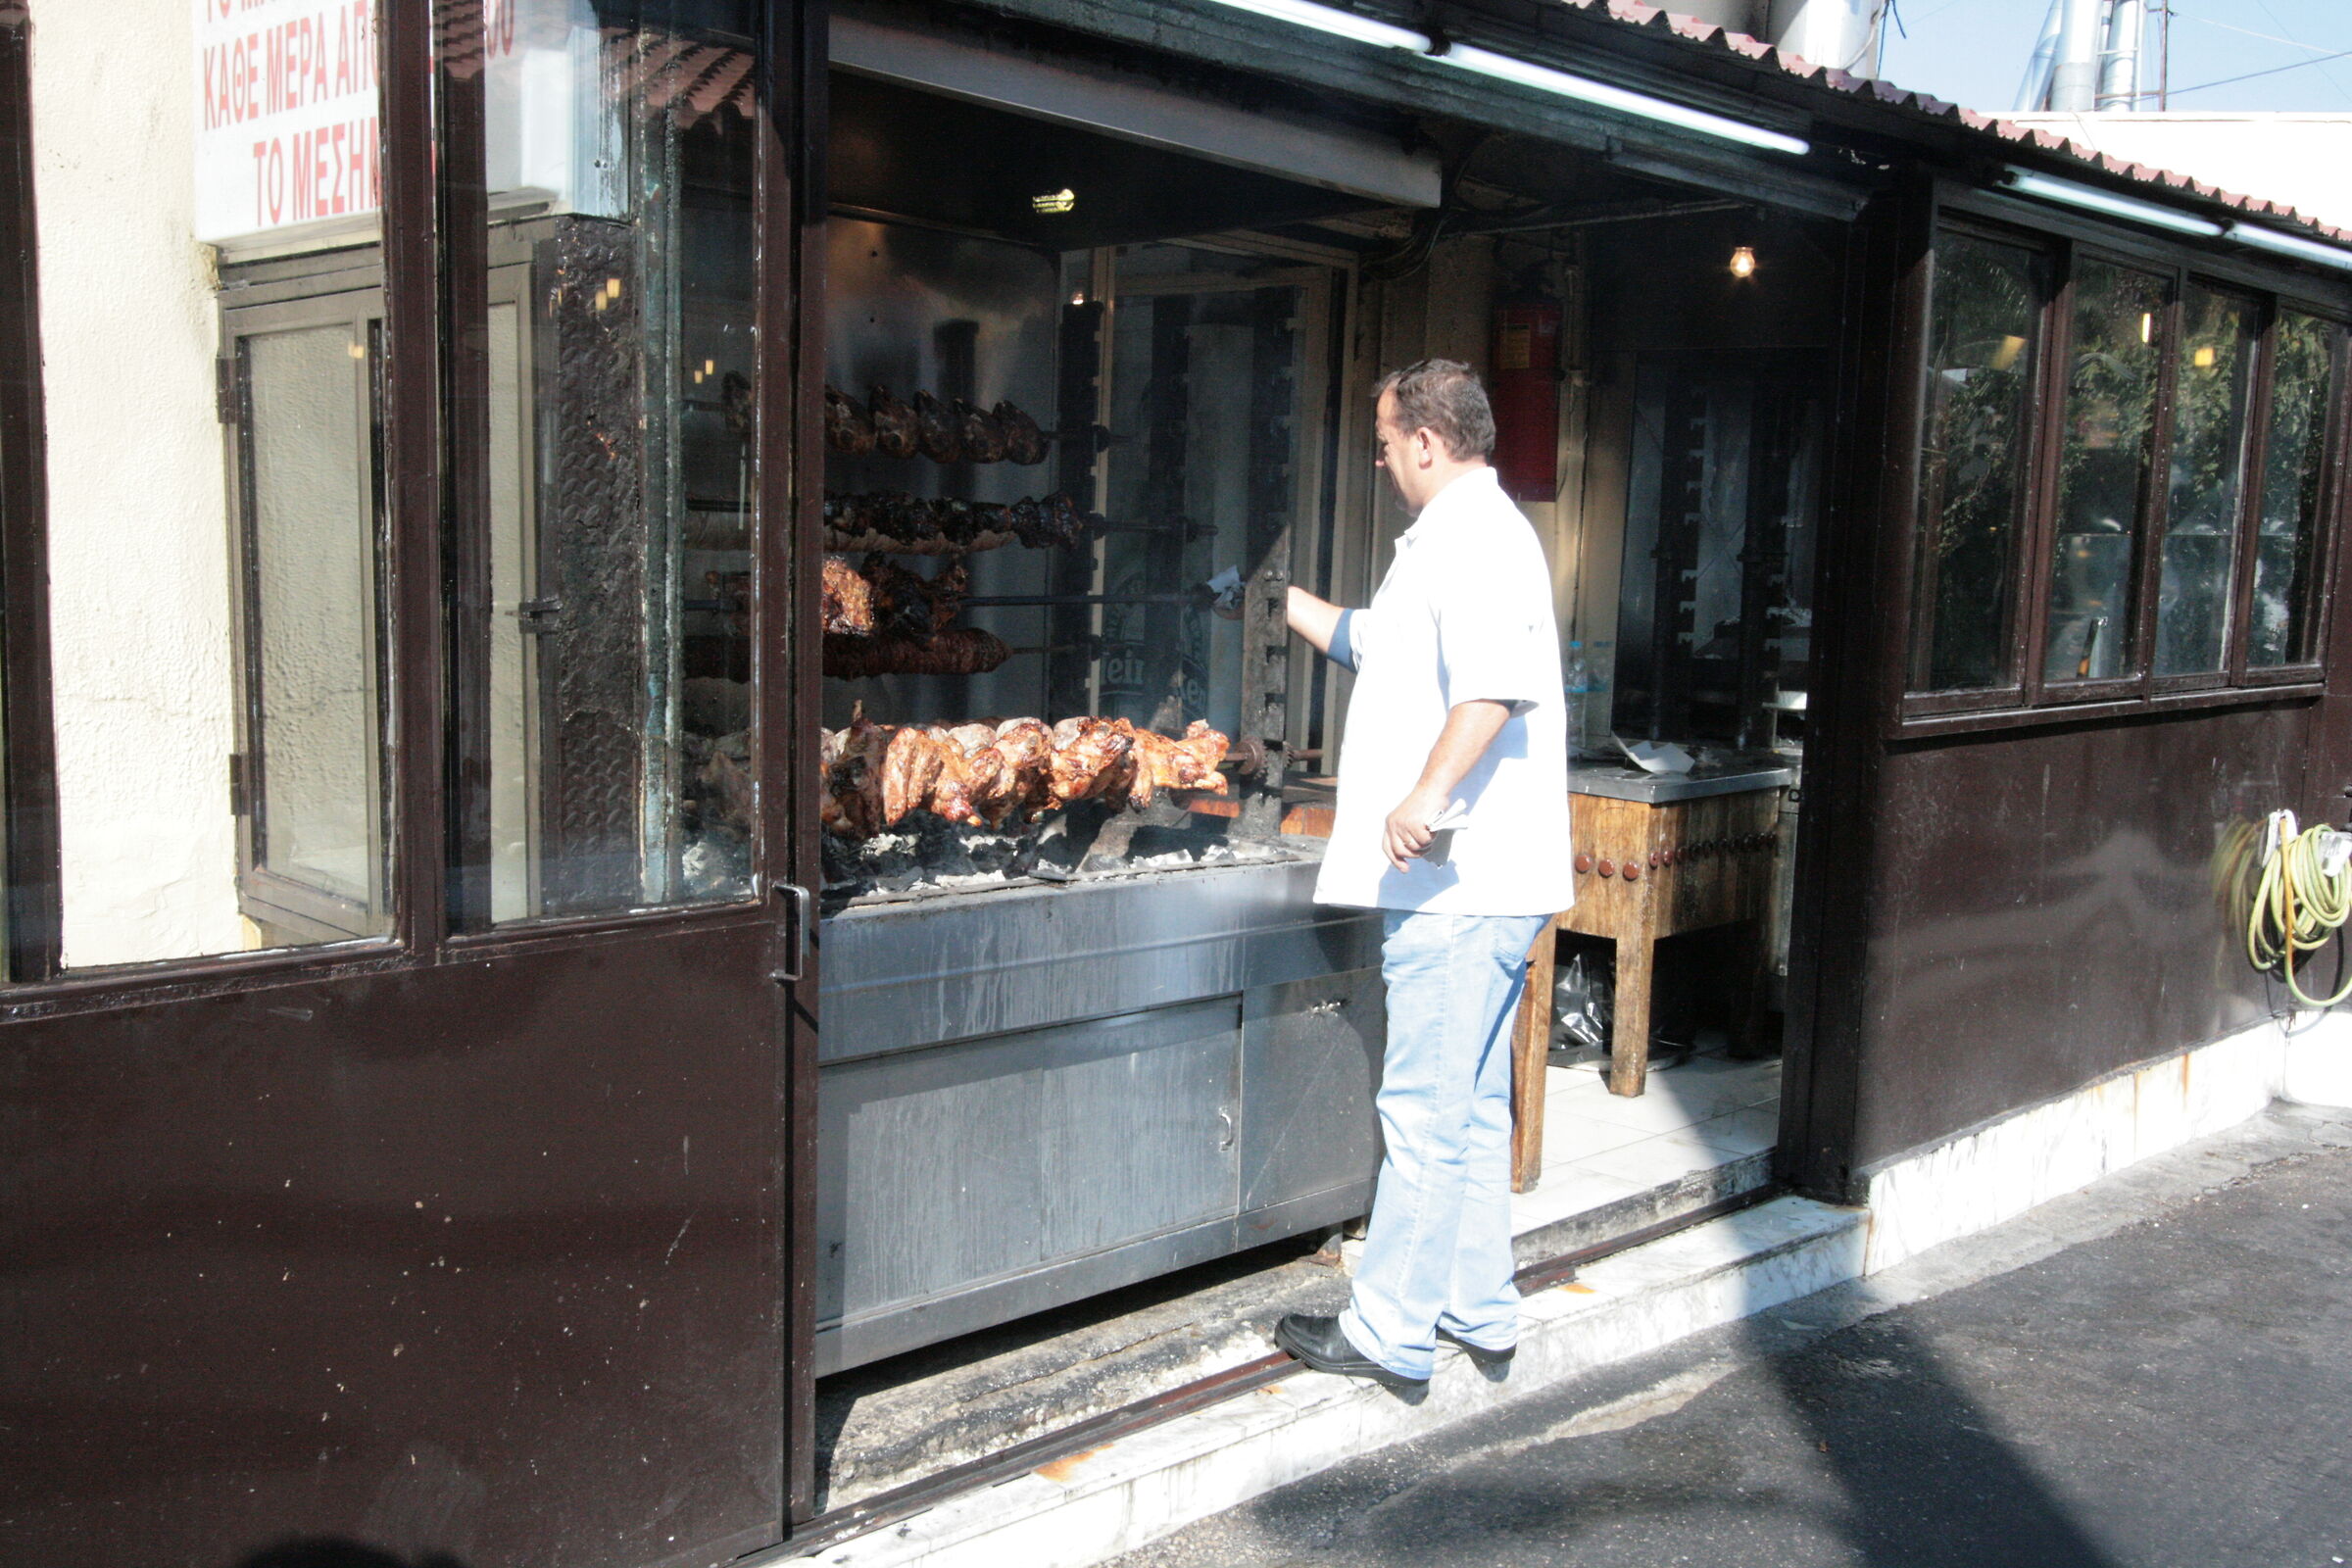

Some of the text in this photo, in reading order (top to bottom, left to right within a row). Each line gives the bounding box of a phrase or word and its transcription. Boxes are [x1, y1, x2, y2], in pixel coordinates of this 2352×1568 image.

[204, 32, 259, 131] ΚΑΘΕ
[267, 12, 328, 116] ΜΕΡΑ
[253, 136, 284, 227] ΤΟ
